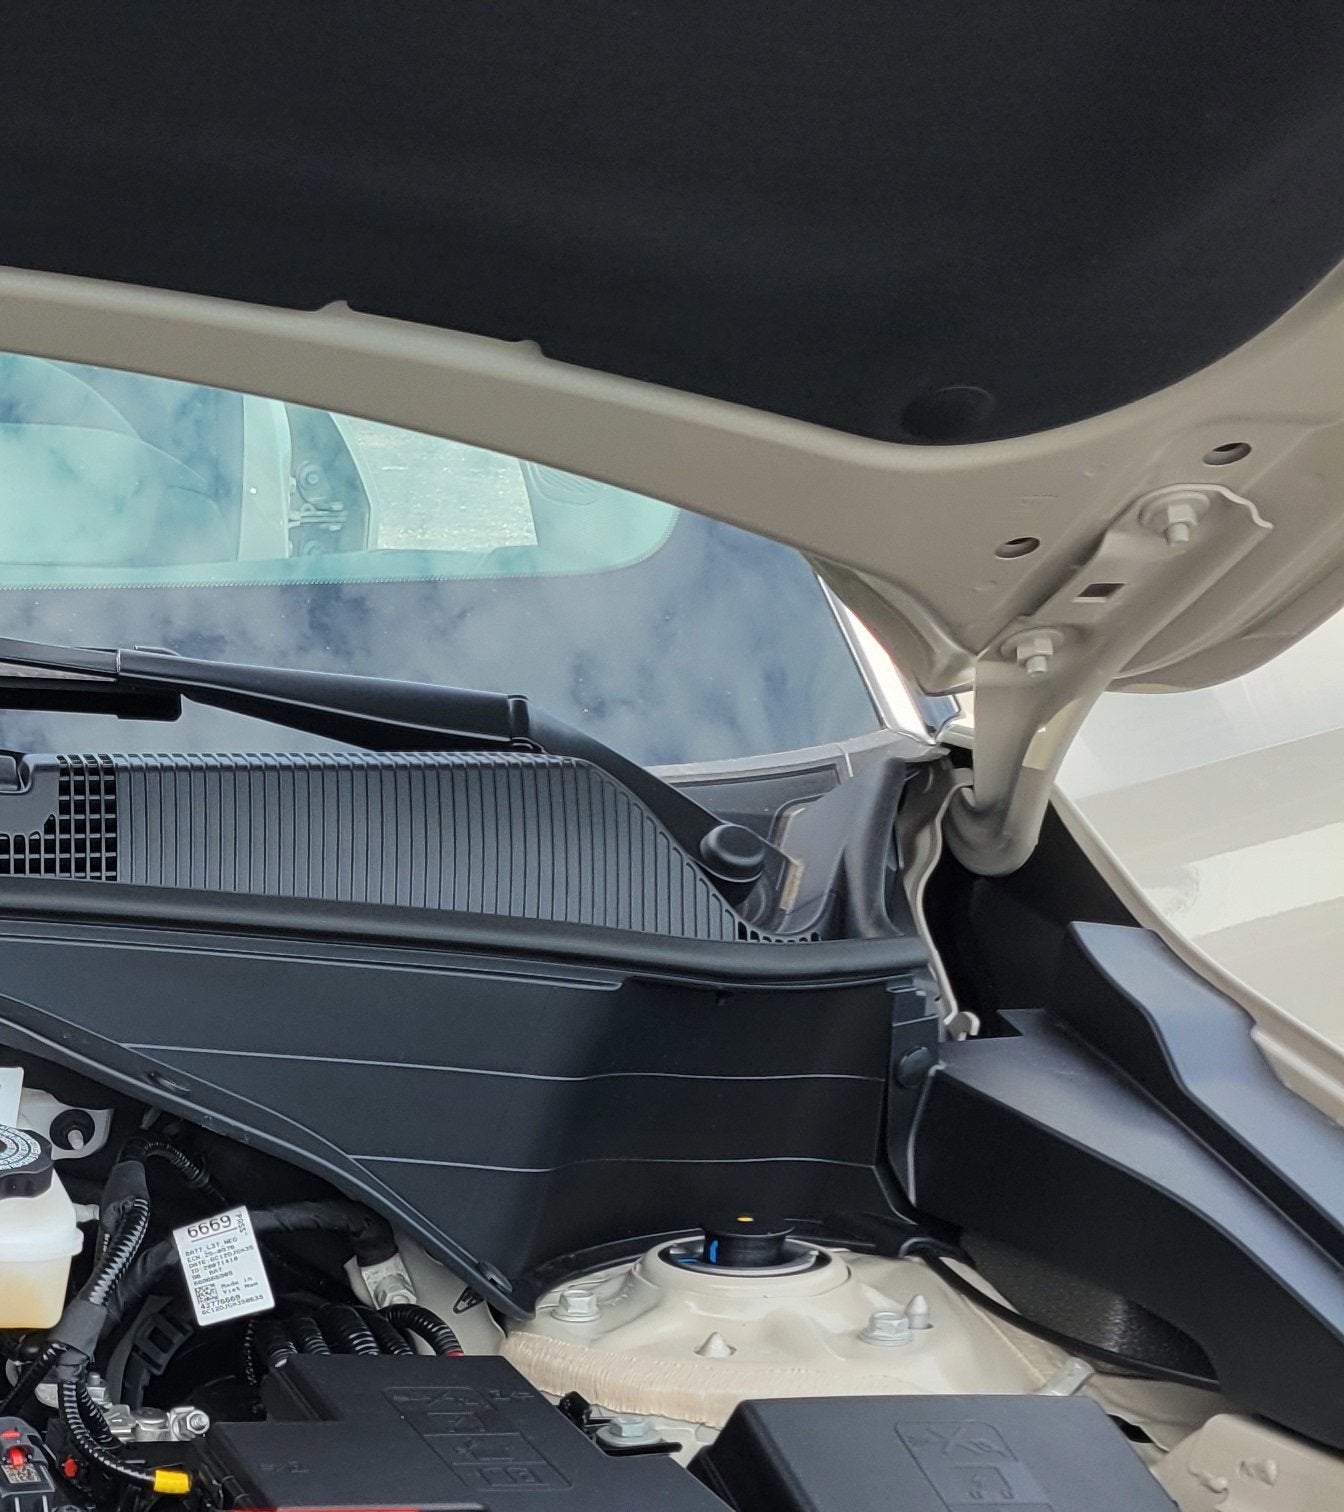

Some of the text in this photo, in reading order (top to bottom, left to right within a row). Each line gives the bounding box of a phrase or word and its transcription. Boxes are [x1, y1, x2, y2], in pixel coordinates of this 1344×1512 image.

[187, 1215, 232, 1238] 6669
[221, 1280, 239, 1289] Made
[223, 1281, 258, 1295] Viet Nam
